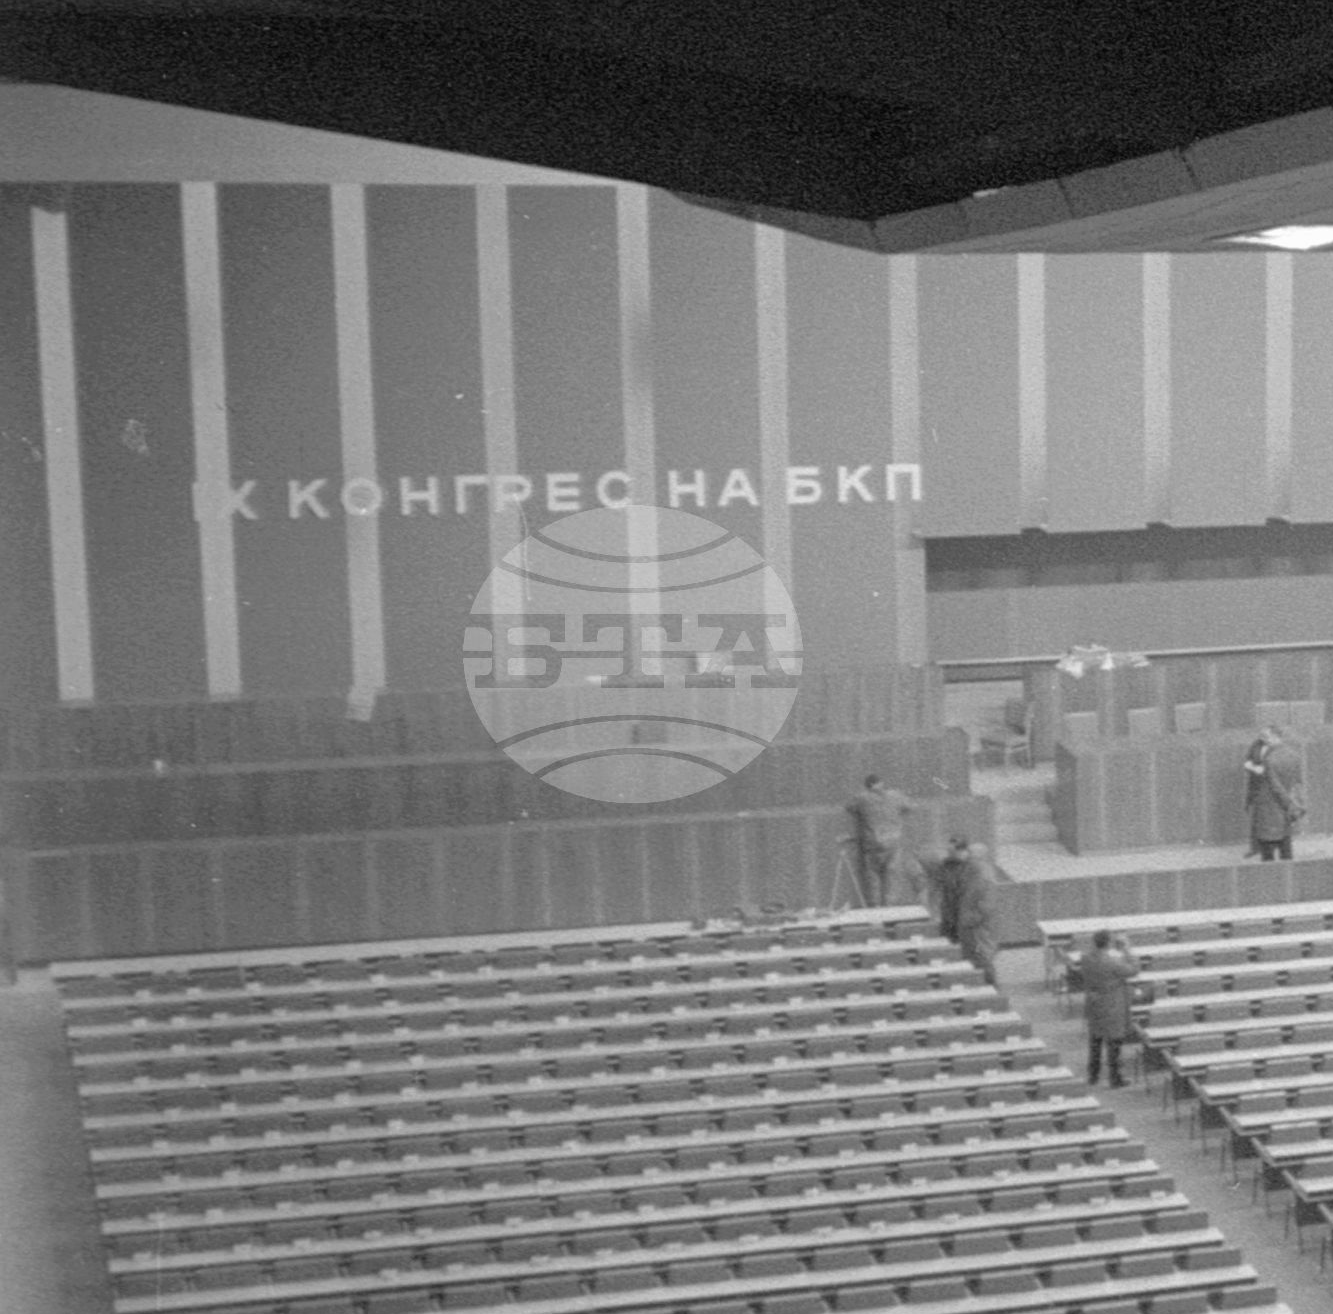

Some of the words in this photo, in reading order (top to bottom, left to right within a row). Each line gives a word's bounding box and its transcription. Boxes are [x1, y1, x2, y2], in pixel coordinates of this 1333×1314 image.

[288, 470, 634, 519] КОНГРЕС
[667, 468, 759, 508] НА
[785, 462, 923, 505] БКП
